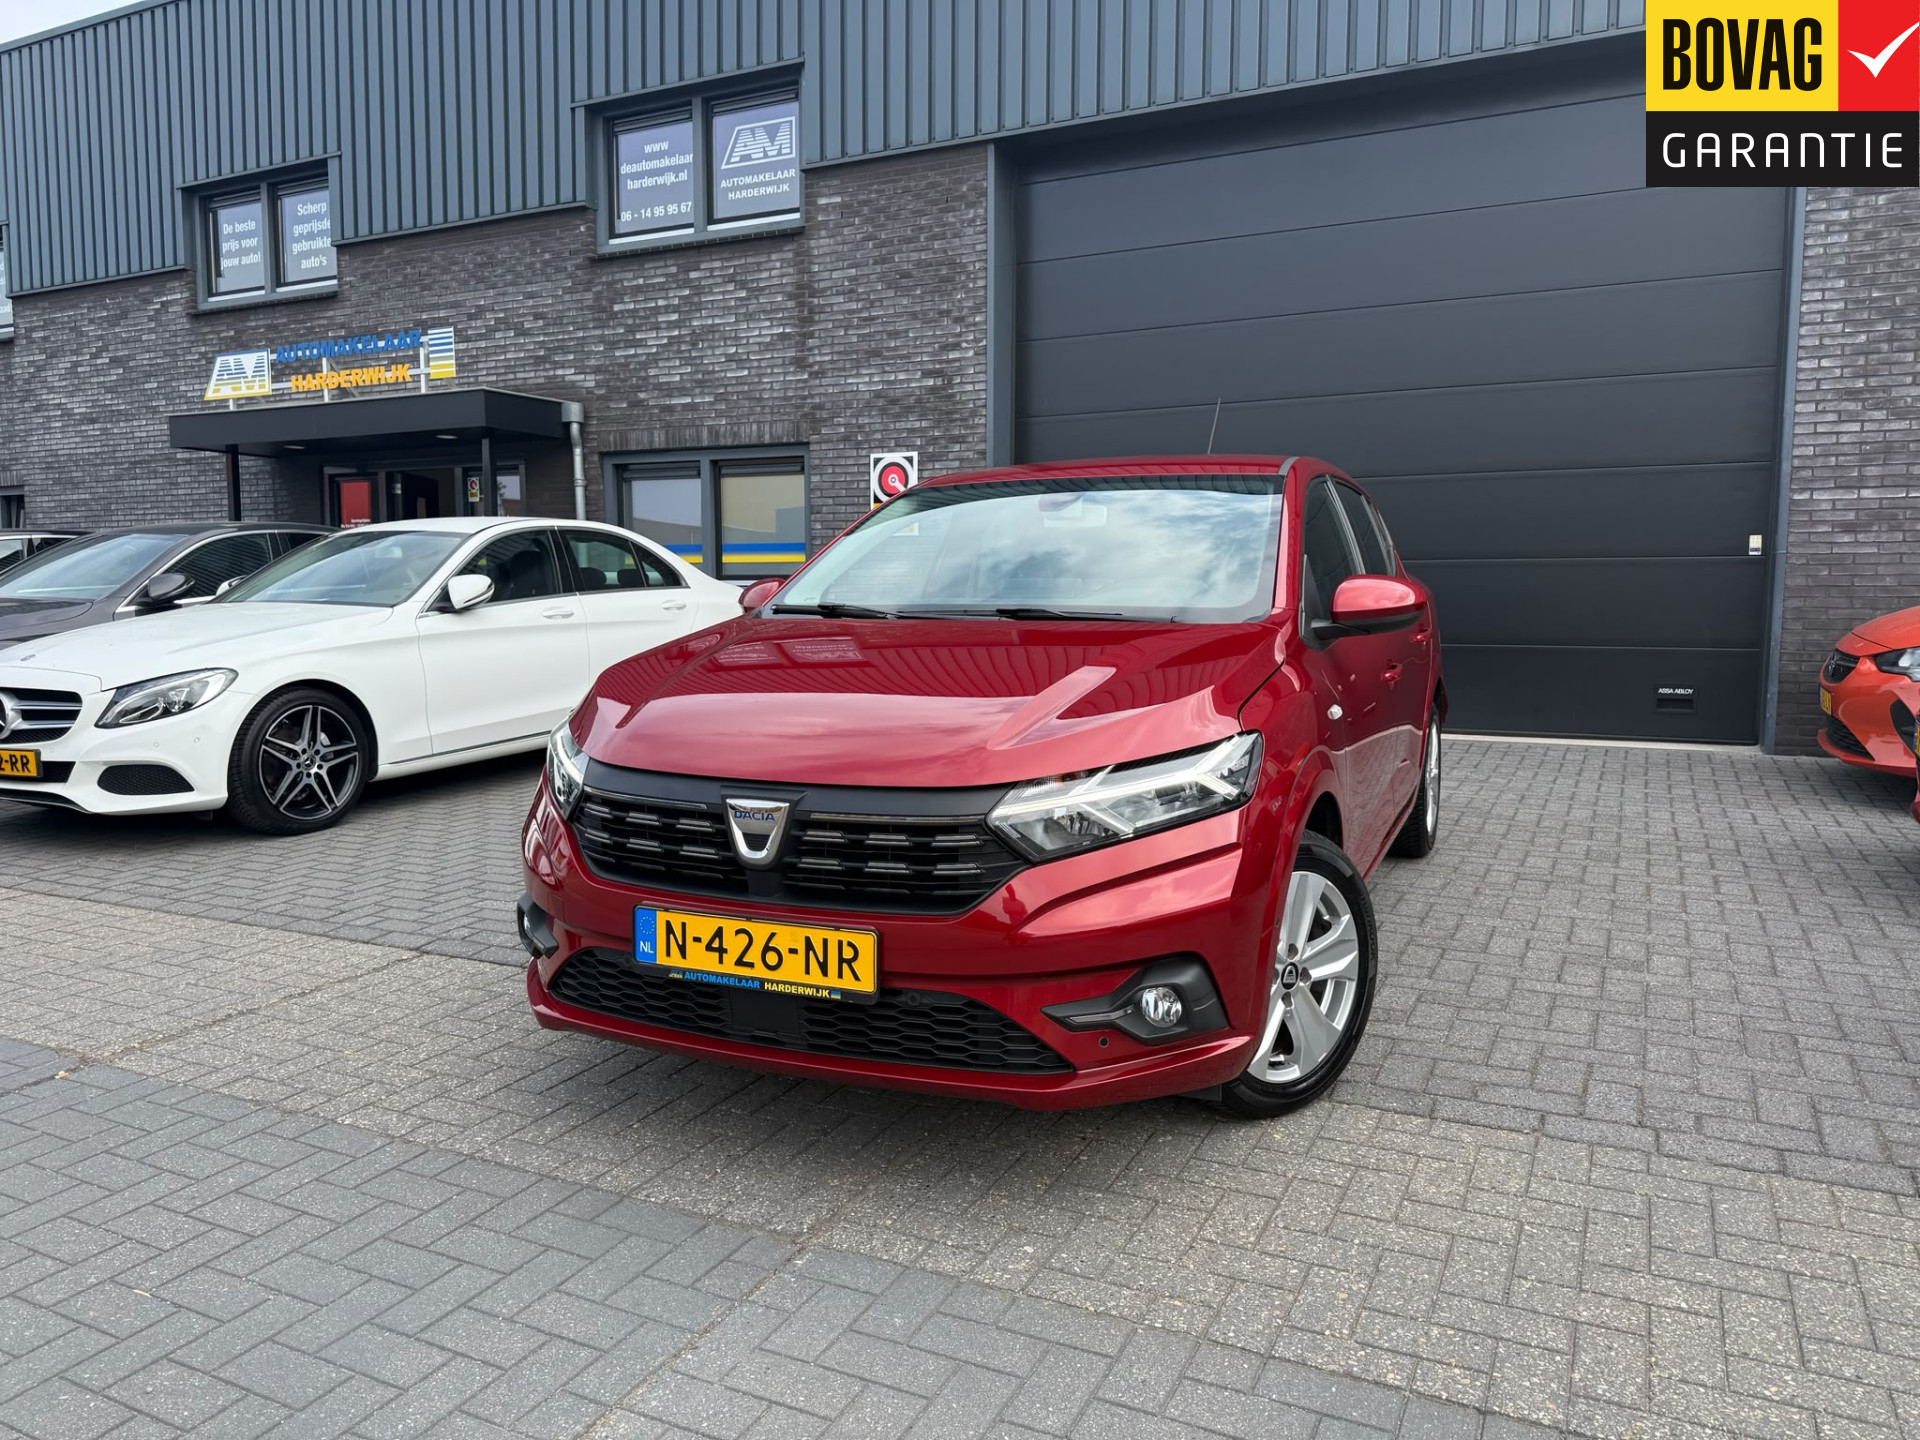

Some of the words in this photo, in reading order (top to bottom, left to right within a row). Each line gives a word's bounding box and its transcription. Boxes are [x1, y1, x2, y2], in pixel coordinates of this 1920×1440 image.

[644, 140, 669, 154] www
[620, 153, 694, 175] deautomakelaar
[627, 169, 688, 190] harderwijk.nl
[720, 168, 796, 188] AUTOMAKELAAR
[728, 183, 790, 200] HARDERWIJK
[297, 202, 327, 216] Scherp
[620, 210, 632, 222] 06
[640, 207, 652, 220] 14
[654, 204, 665, 217] 95
[667, 203, 679, 215] 95
[680, 201, 692, 213] 67
[223, 223, 233, 235] De
[234, 220, 256, 232] beste
[222, 239, 239, 253] prijs
[241, 237, 259, 248] voor
[292, 237, 332, 255] gebruikte
[220, 256, 239, 270] jouw
[241, 251, 261, 264] auto!
[301, 254, 327, 269] auto's
[275, 329, 422, 364] AUTOMAKELAAR
[290, 363, 412, 393] HARDERWIJK
[734, 810, 776, 822] DACIA
[639, 940, 654, 954] NL
[665, 919, 861, 981] N-426-NR
[684, 971, 760, 989] AUTOMAKELAAR
[764, 981, 830, 998] HARDERWIJK
